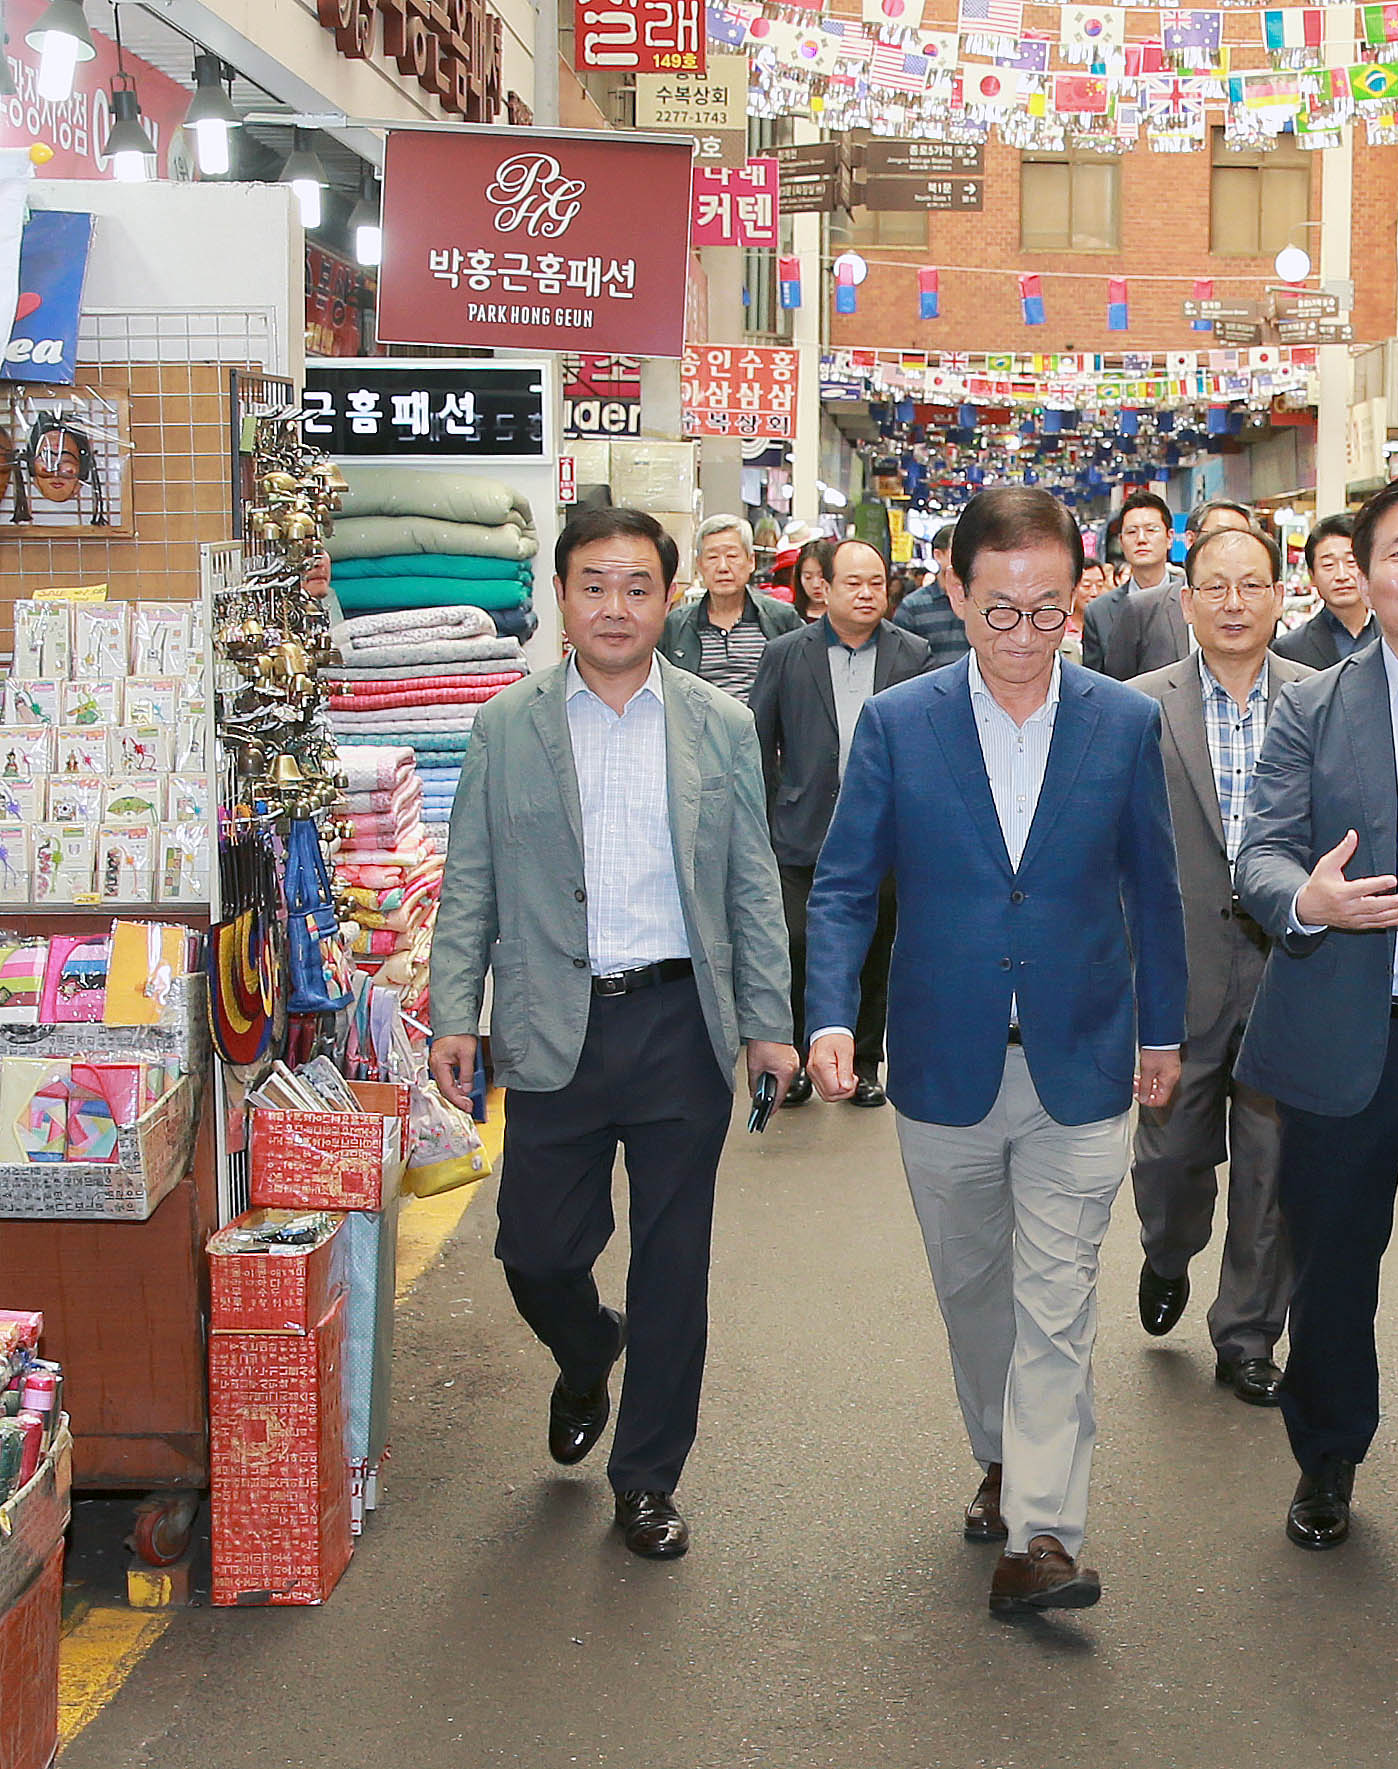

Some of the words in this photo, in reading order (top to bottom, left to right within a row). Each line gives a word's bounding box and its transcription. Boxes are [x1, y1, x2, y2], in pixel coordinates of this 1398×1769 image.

[653, 53, 699, 69] 149호
[656, 86, 728, 107] 수복상회
[656, 111, 728, 124] 2277-1743
[697, 193, 773, 239] 커텐
[429, 247, 635, 299] 박홍근홈패션
[468, 303, 508, 323] PARK
[510, 305, 551, 325] HONG
[555, 307, 594, 328] GEUN
